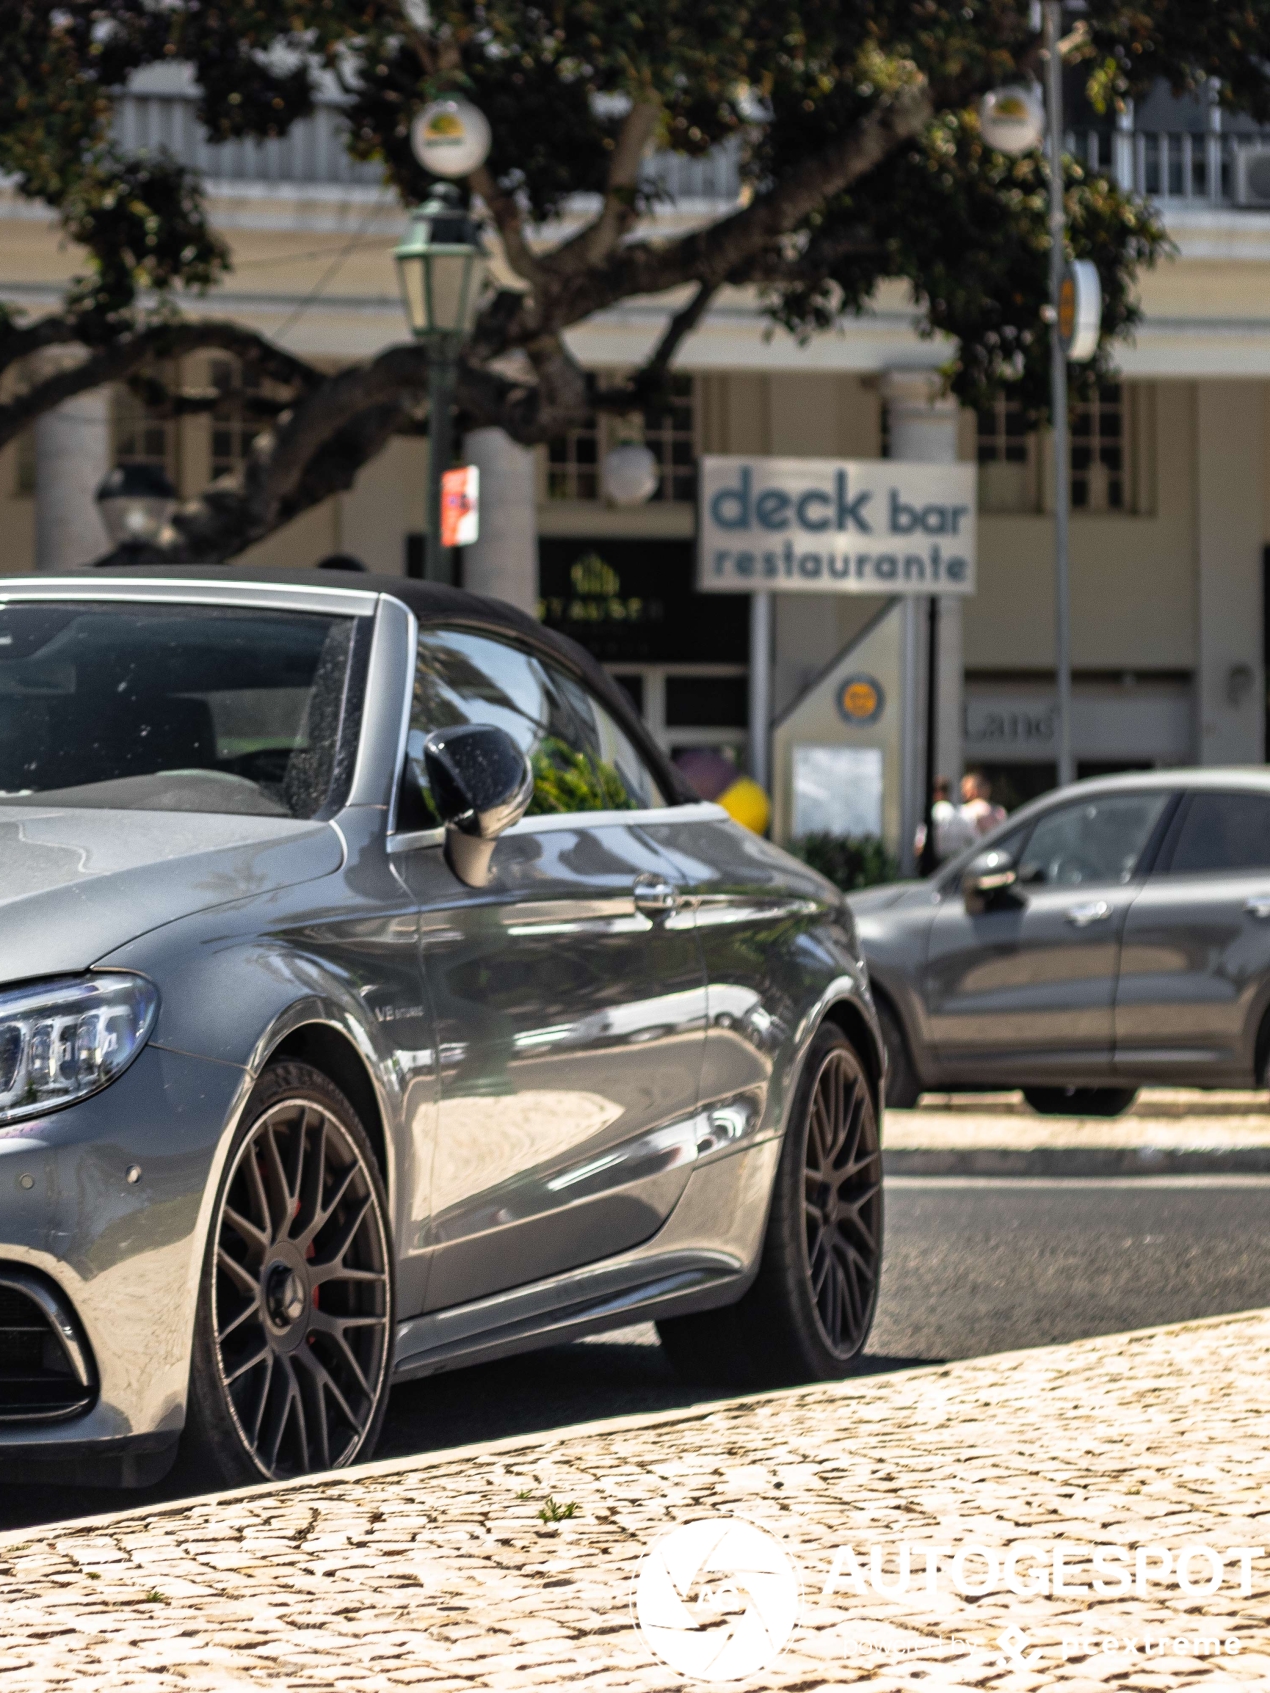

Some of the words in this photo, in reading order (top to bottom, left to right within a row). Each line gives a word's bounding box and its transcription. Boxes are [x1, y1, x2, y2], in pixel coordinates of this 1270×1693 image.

[710, 464, 873, 532] deck
[888, 487, 969, 535] bar
[713, 539, 969, 582] restaurante
